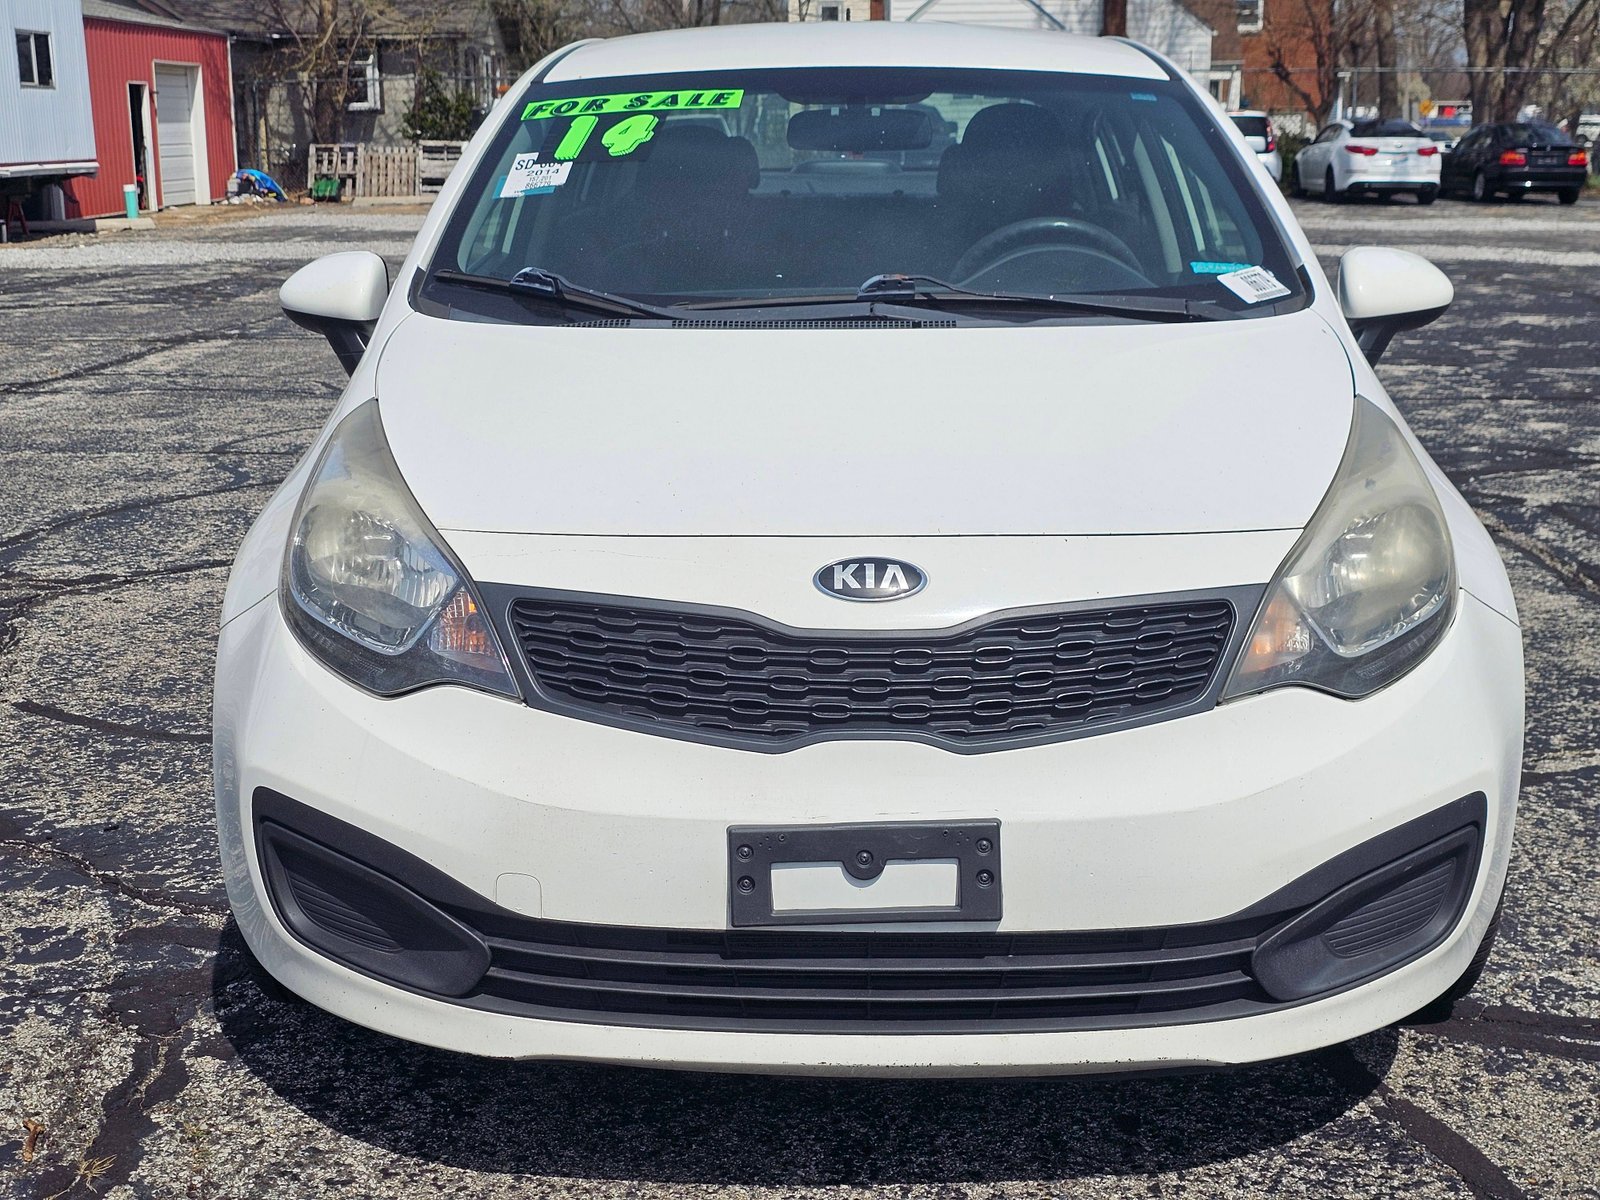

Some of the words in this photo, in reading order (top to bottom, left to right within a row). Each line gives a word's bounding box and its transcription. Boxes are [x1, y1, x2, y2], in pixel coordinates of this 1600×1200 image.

[526, 98, 611, 118] FOR
[624, 92, 735, 110] SALE
[554, 115, 659, 160] 14
[832, 563, 909, 590] KIA
